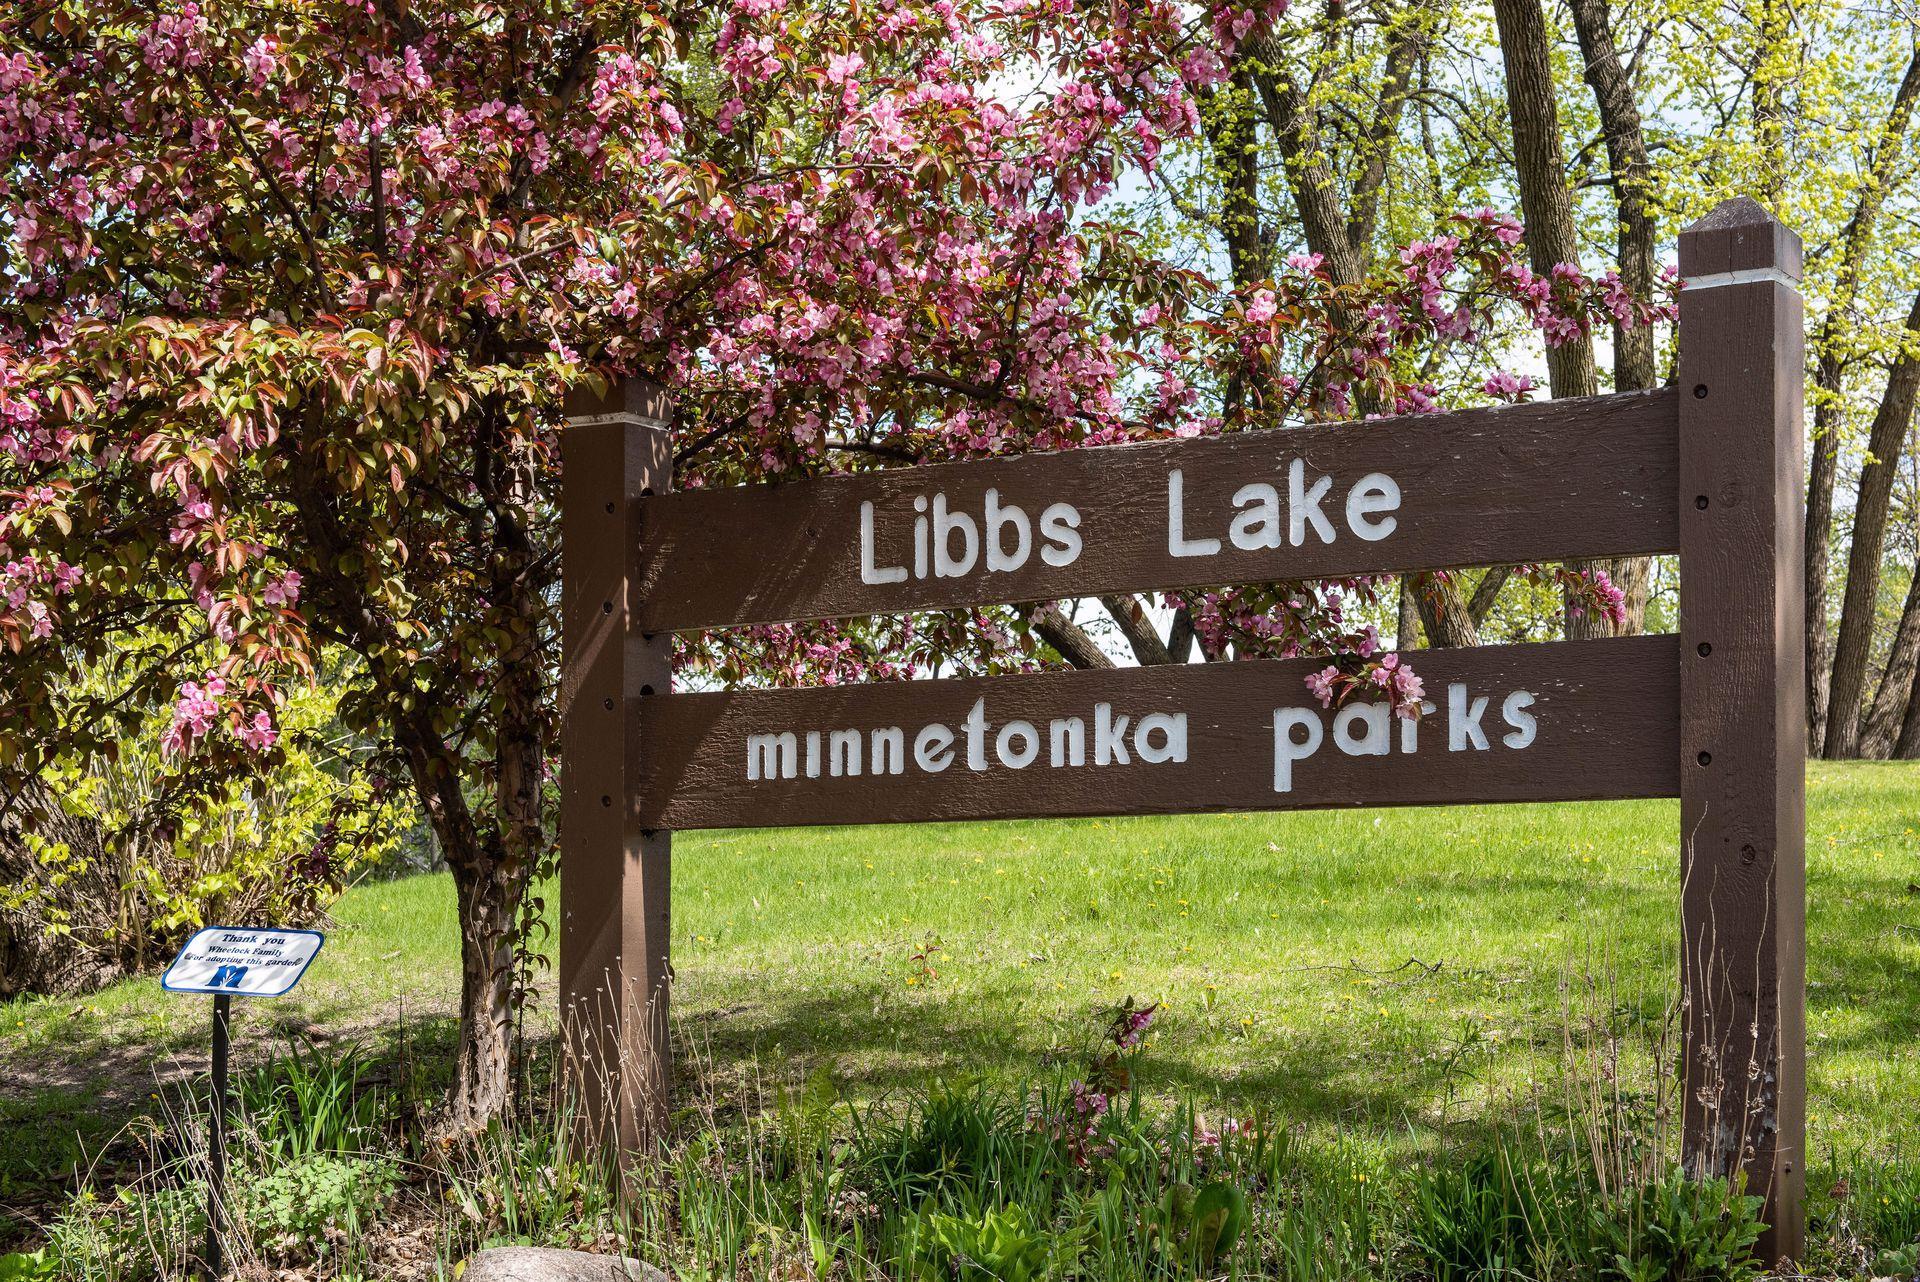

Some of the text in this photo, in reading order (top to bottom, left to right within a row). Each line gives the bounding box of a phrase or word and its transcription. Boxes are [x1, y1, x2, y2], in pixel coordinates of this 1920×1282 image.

[860, 457, 1402, 586] Libbs Lake
[746, 697, 1188, 781] minnetonka
[222, 934, 257, 943] Thank
[208, 945, 285, 957] Wheelock Family
[205, 955, 244, 964] adopting
[246, 957, 263, 965] this
